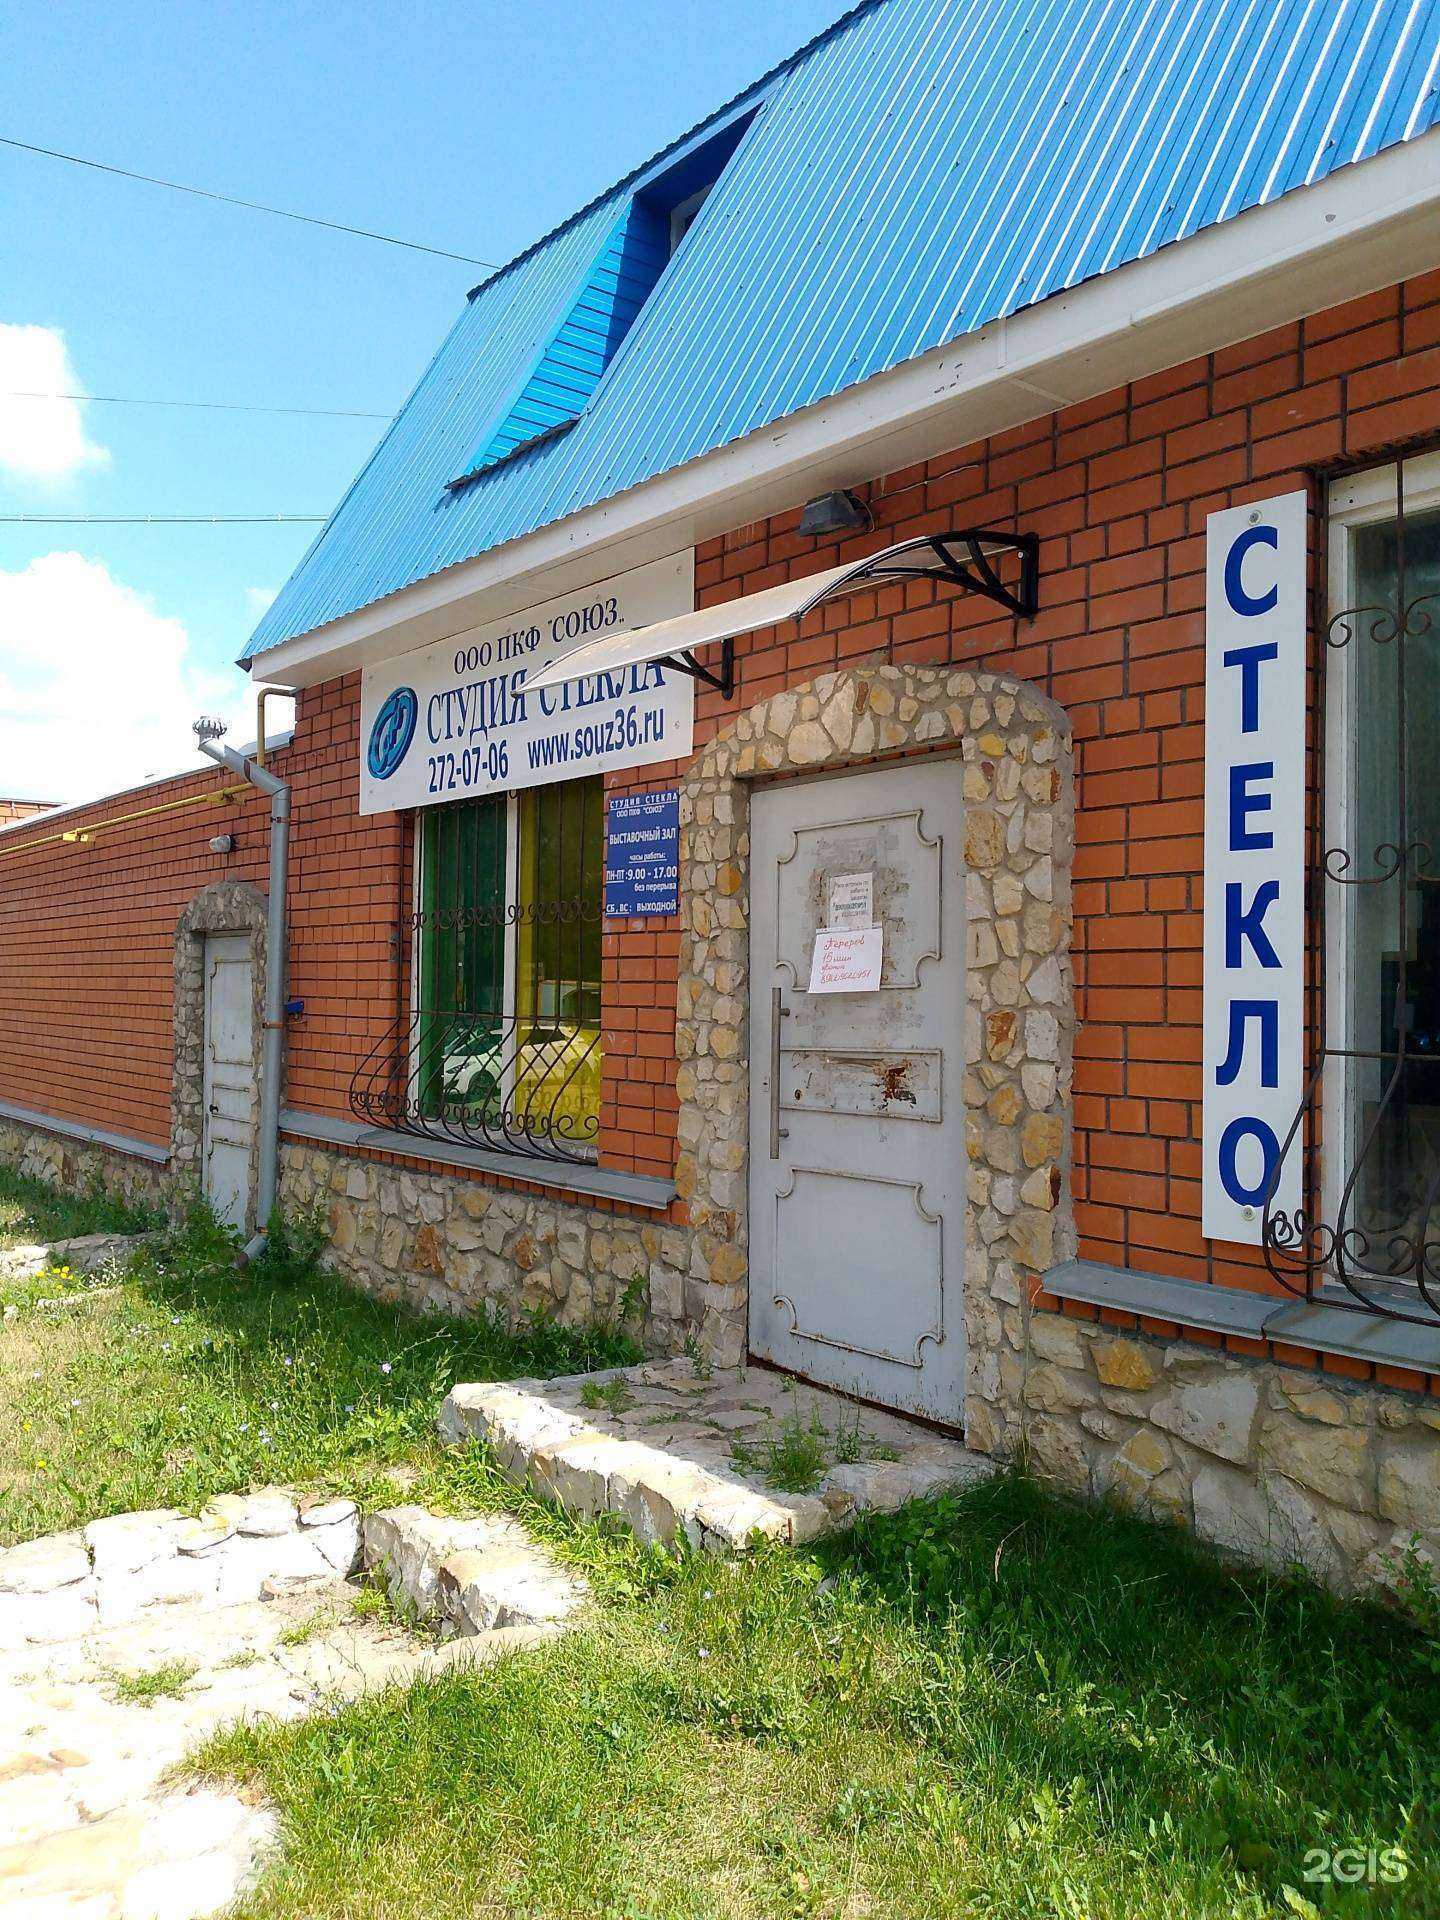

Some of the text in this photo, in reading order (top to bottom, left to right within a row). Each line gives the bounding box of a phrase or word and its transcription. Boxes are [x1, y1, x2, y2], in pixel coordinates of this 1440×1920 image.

[454, 642, 492, 674] ООО
[496, 625, 541, 662] ПКФ
[427, 668, 528, 745] СТУДИЯ
[428, 705, 664, 793] 272-07-06 www.souz36.ru
[609, 792, 678, 809] СТУДИЯ СТЕКЛА
[616, 805, 665, 818] ООО ПКФ "СОЮЗ"
[609, 827, 676, 845] ВЫСТАВОЧНЫЙ ЗАЛ
[653, 866, 678, 879] 17.00
[1215, 525, 1283, 1209] СТЕКЛО
[634, 881, 677, 893] без перерыва
[636, 899, 677, 912] ВЫХОДНОЙ
